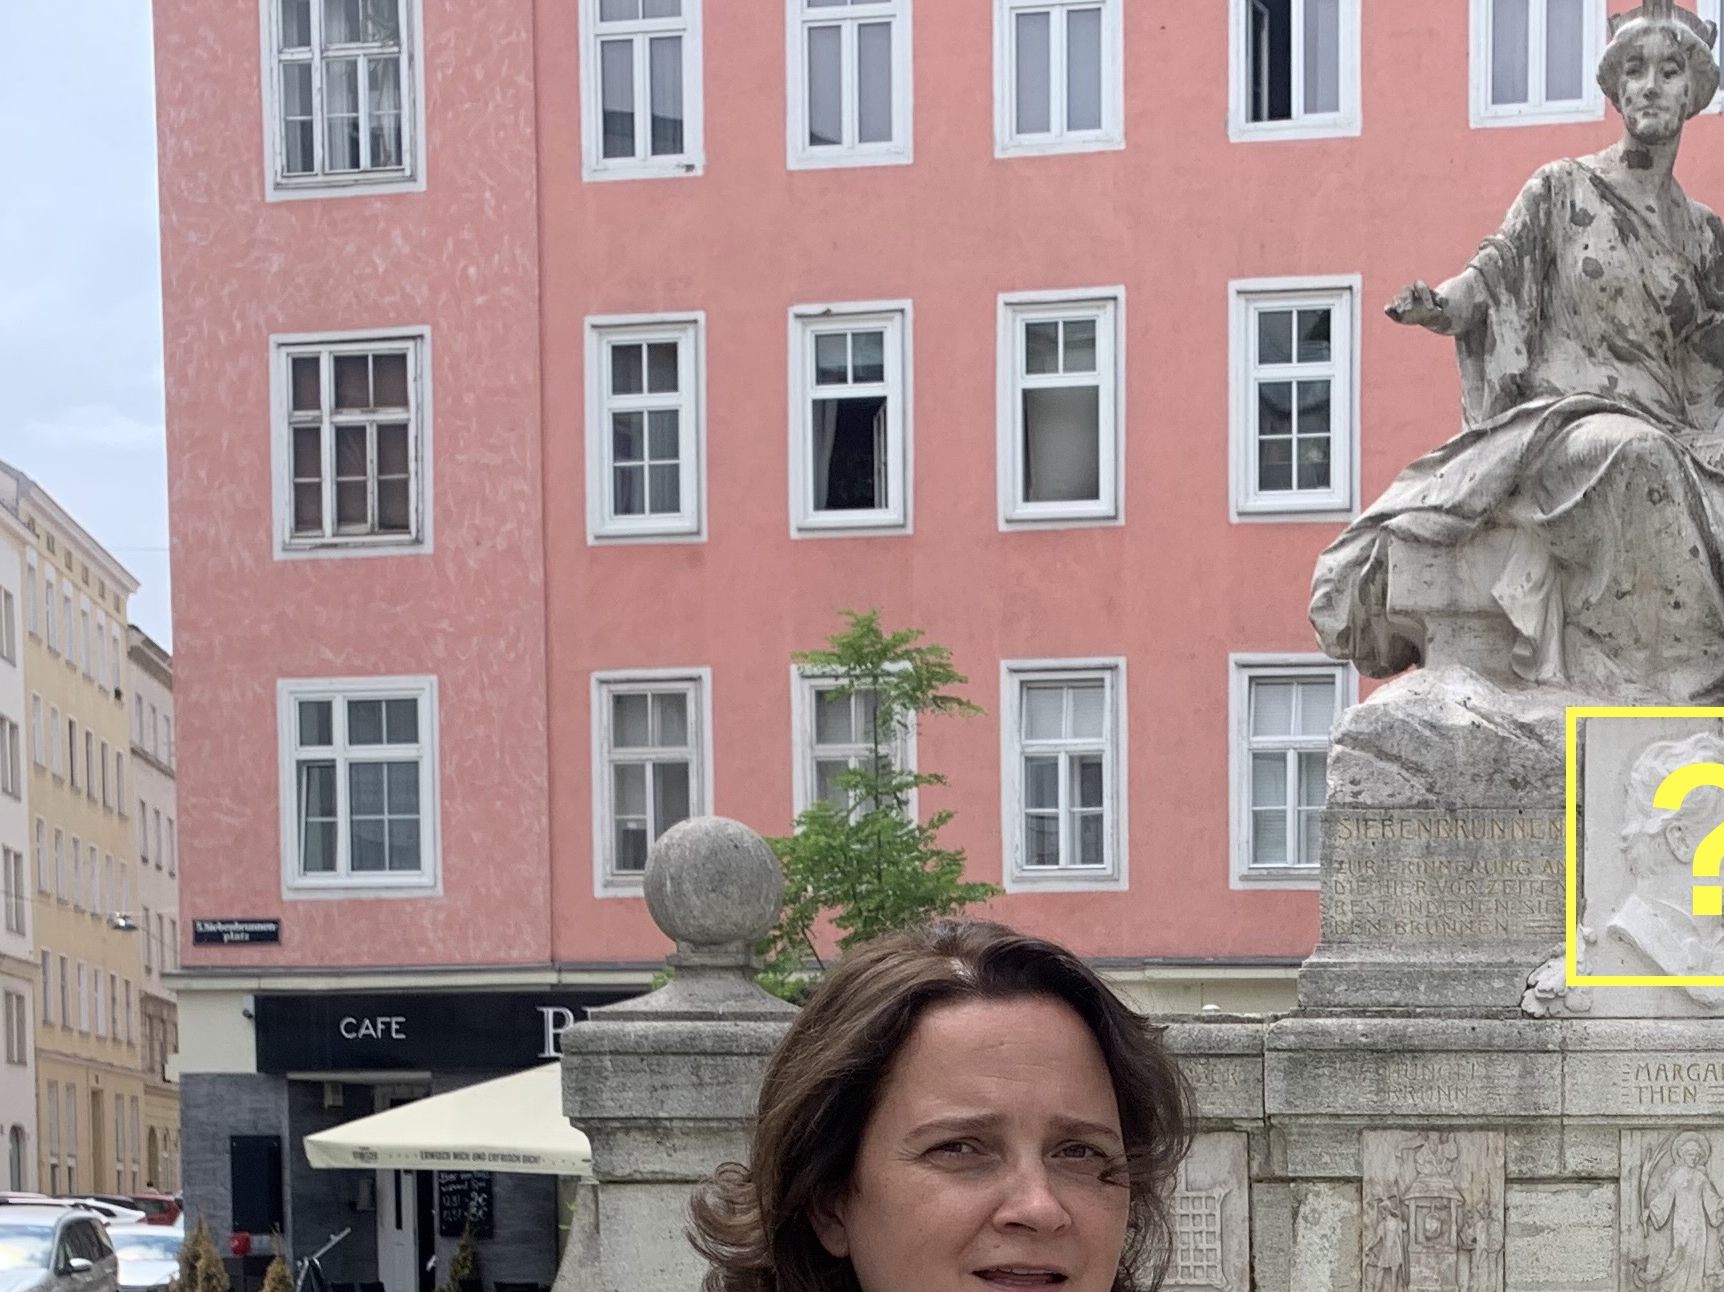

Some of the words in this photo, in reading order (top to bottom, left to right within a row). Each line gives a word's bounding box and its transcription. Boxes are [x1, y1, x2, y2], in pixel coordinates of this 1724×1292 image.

[1338, 817, 1566, 840] SIEBENBRUNNEN
[340, 1017, 406, 1039] CAFE
[1634, 1085, 1697, 1104] THEN
